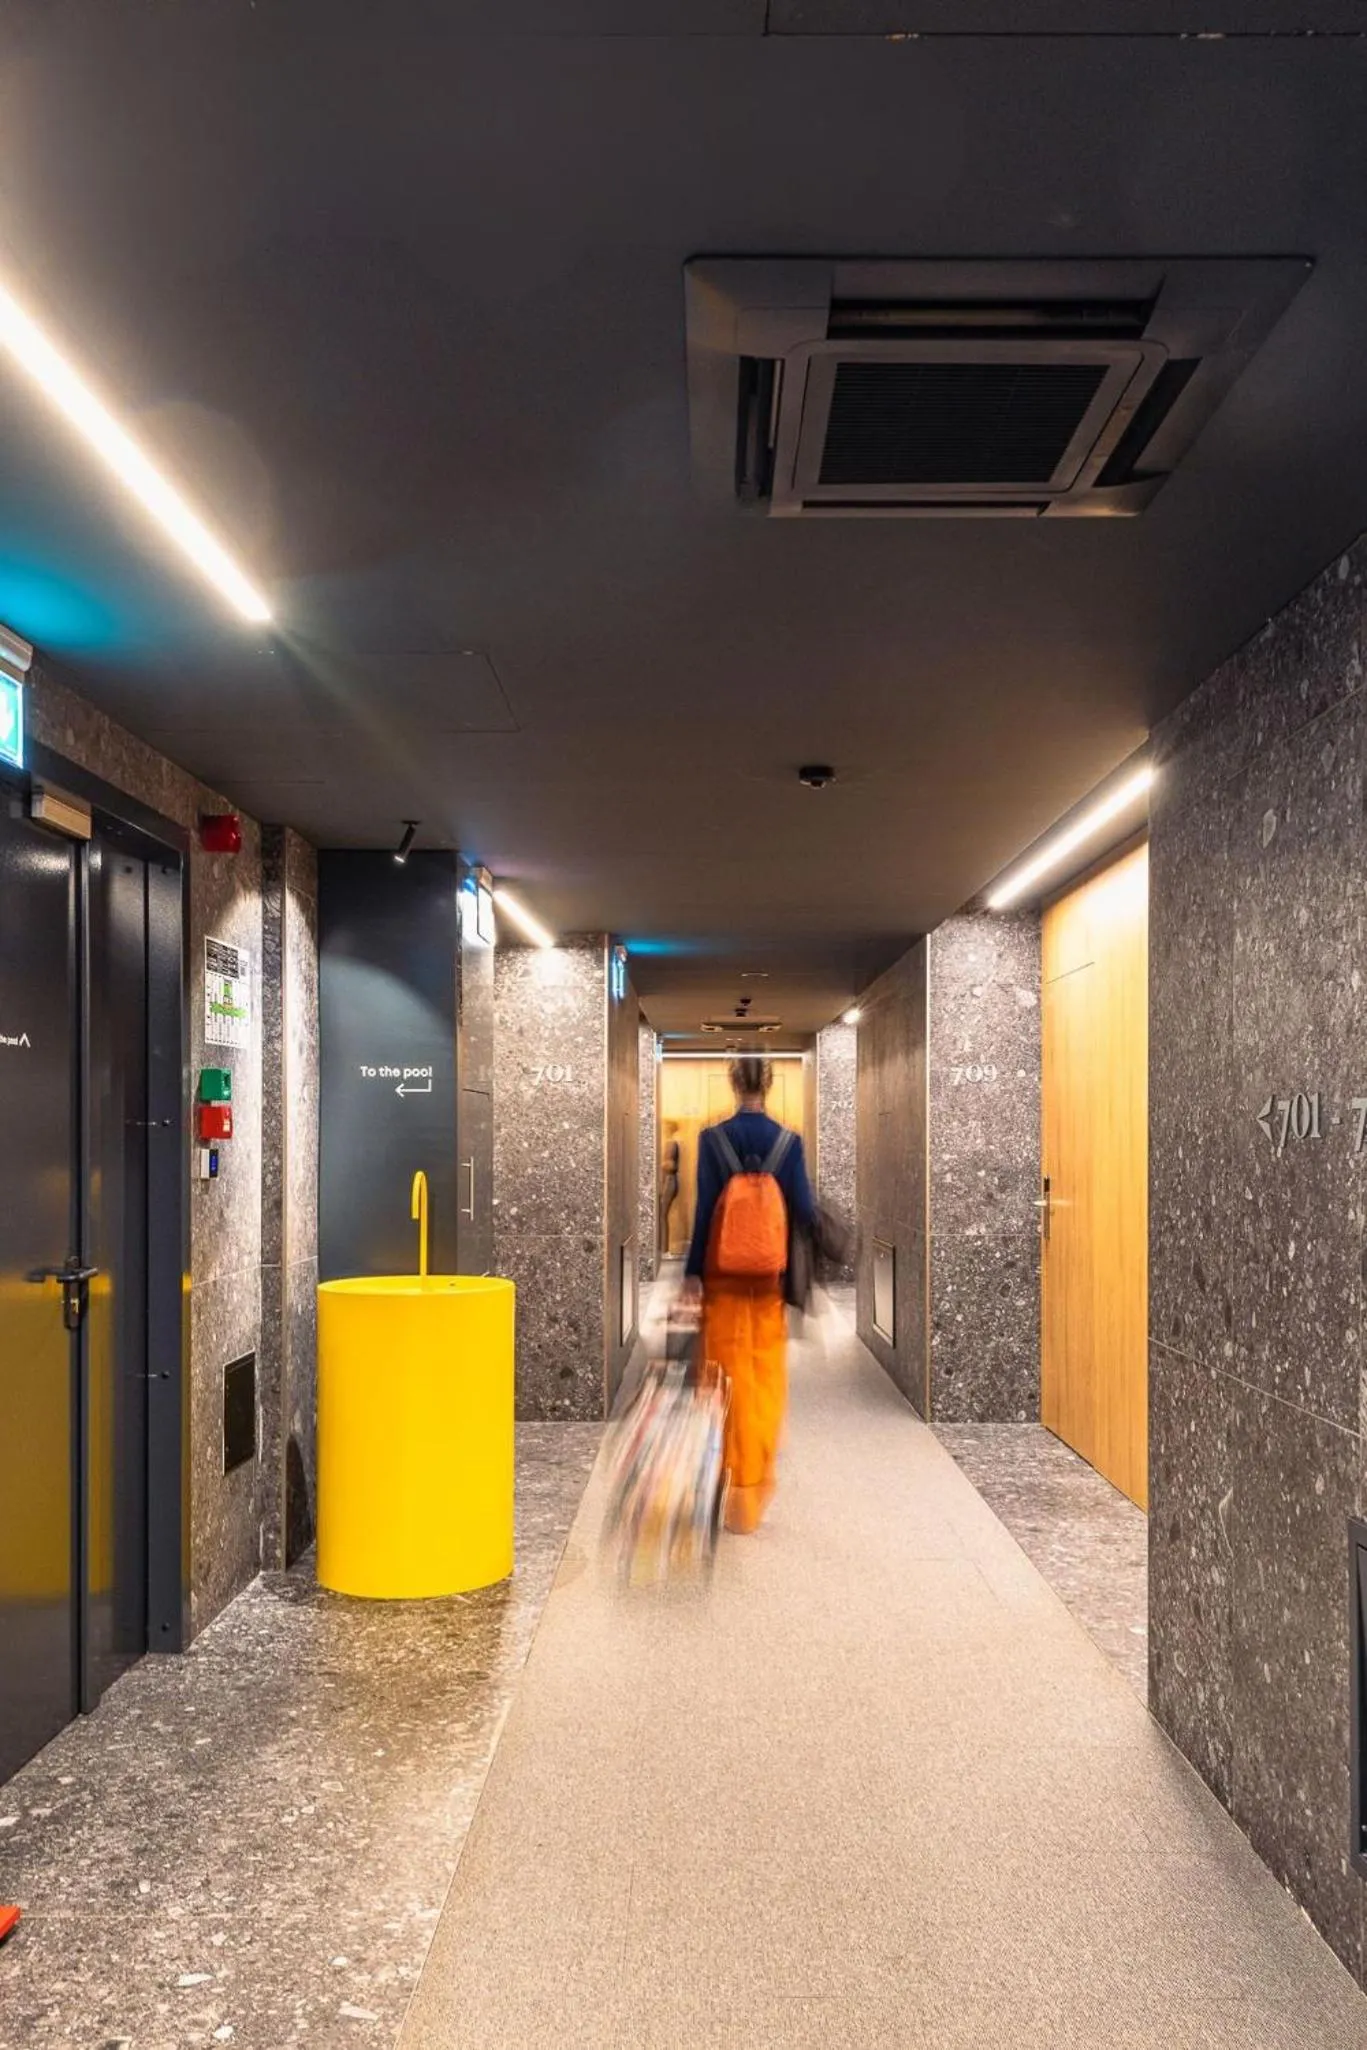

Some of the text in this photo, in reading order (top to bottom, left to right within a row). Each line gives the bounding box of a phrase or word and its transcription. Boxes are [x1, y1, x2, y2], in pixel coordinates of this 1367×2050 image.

[360, 1066, 433, 1080] To the pool
[530, 1064, 574, 1087] 701
[949, 1064, 998, 1086] 709
